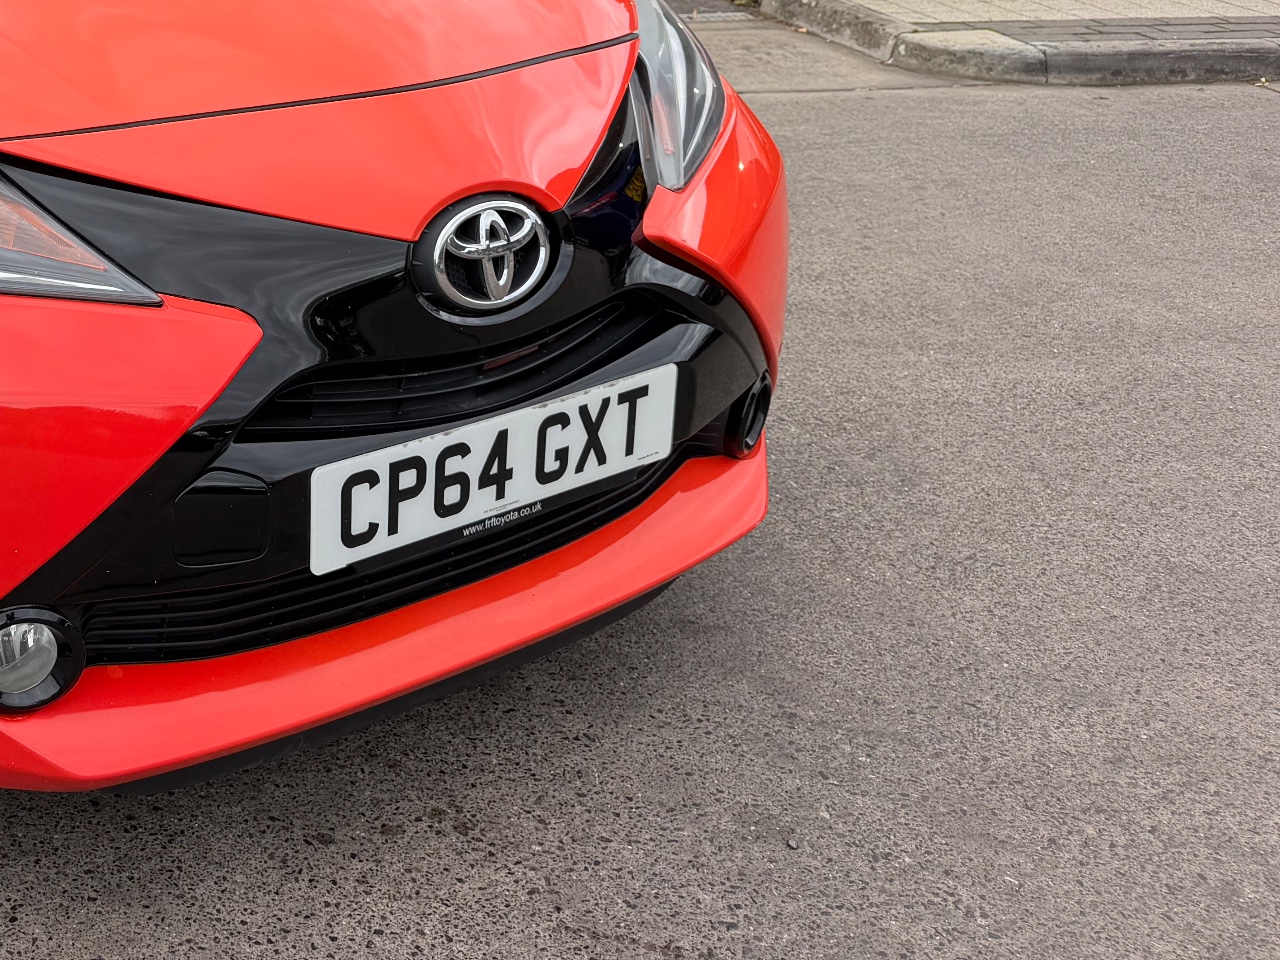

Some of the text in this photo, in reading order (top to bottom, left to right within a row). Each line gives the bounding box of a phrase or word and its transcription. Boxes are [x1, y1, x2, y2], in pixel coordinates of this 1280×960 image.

[340, 383, 650, 549] CP64 GXT
[462, 501, 543, 537] www.frftoyota.co.uk
